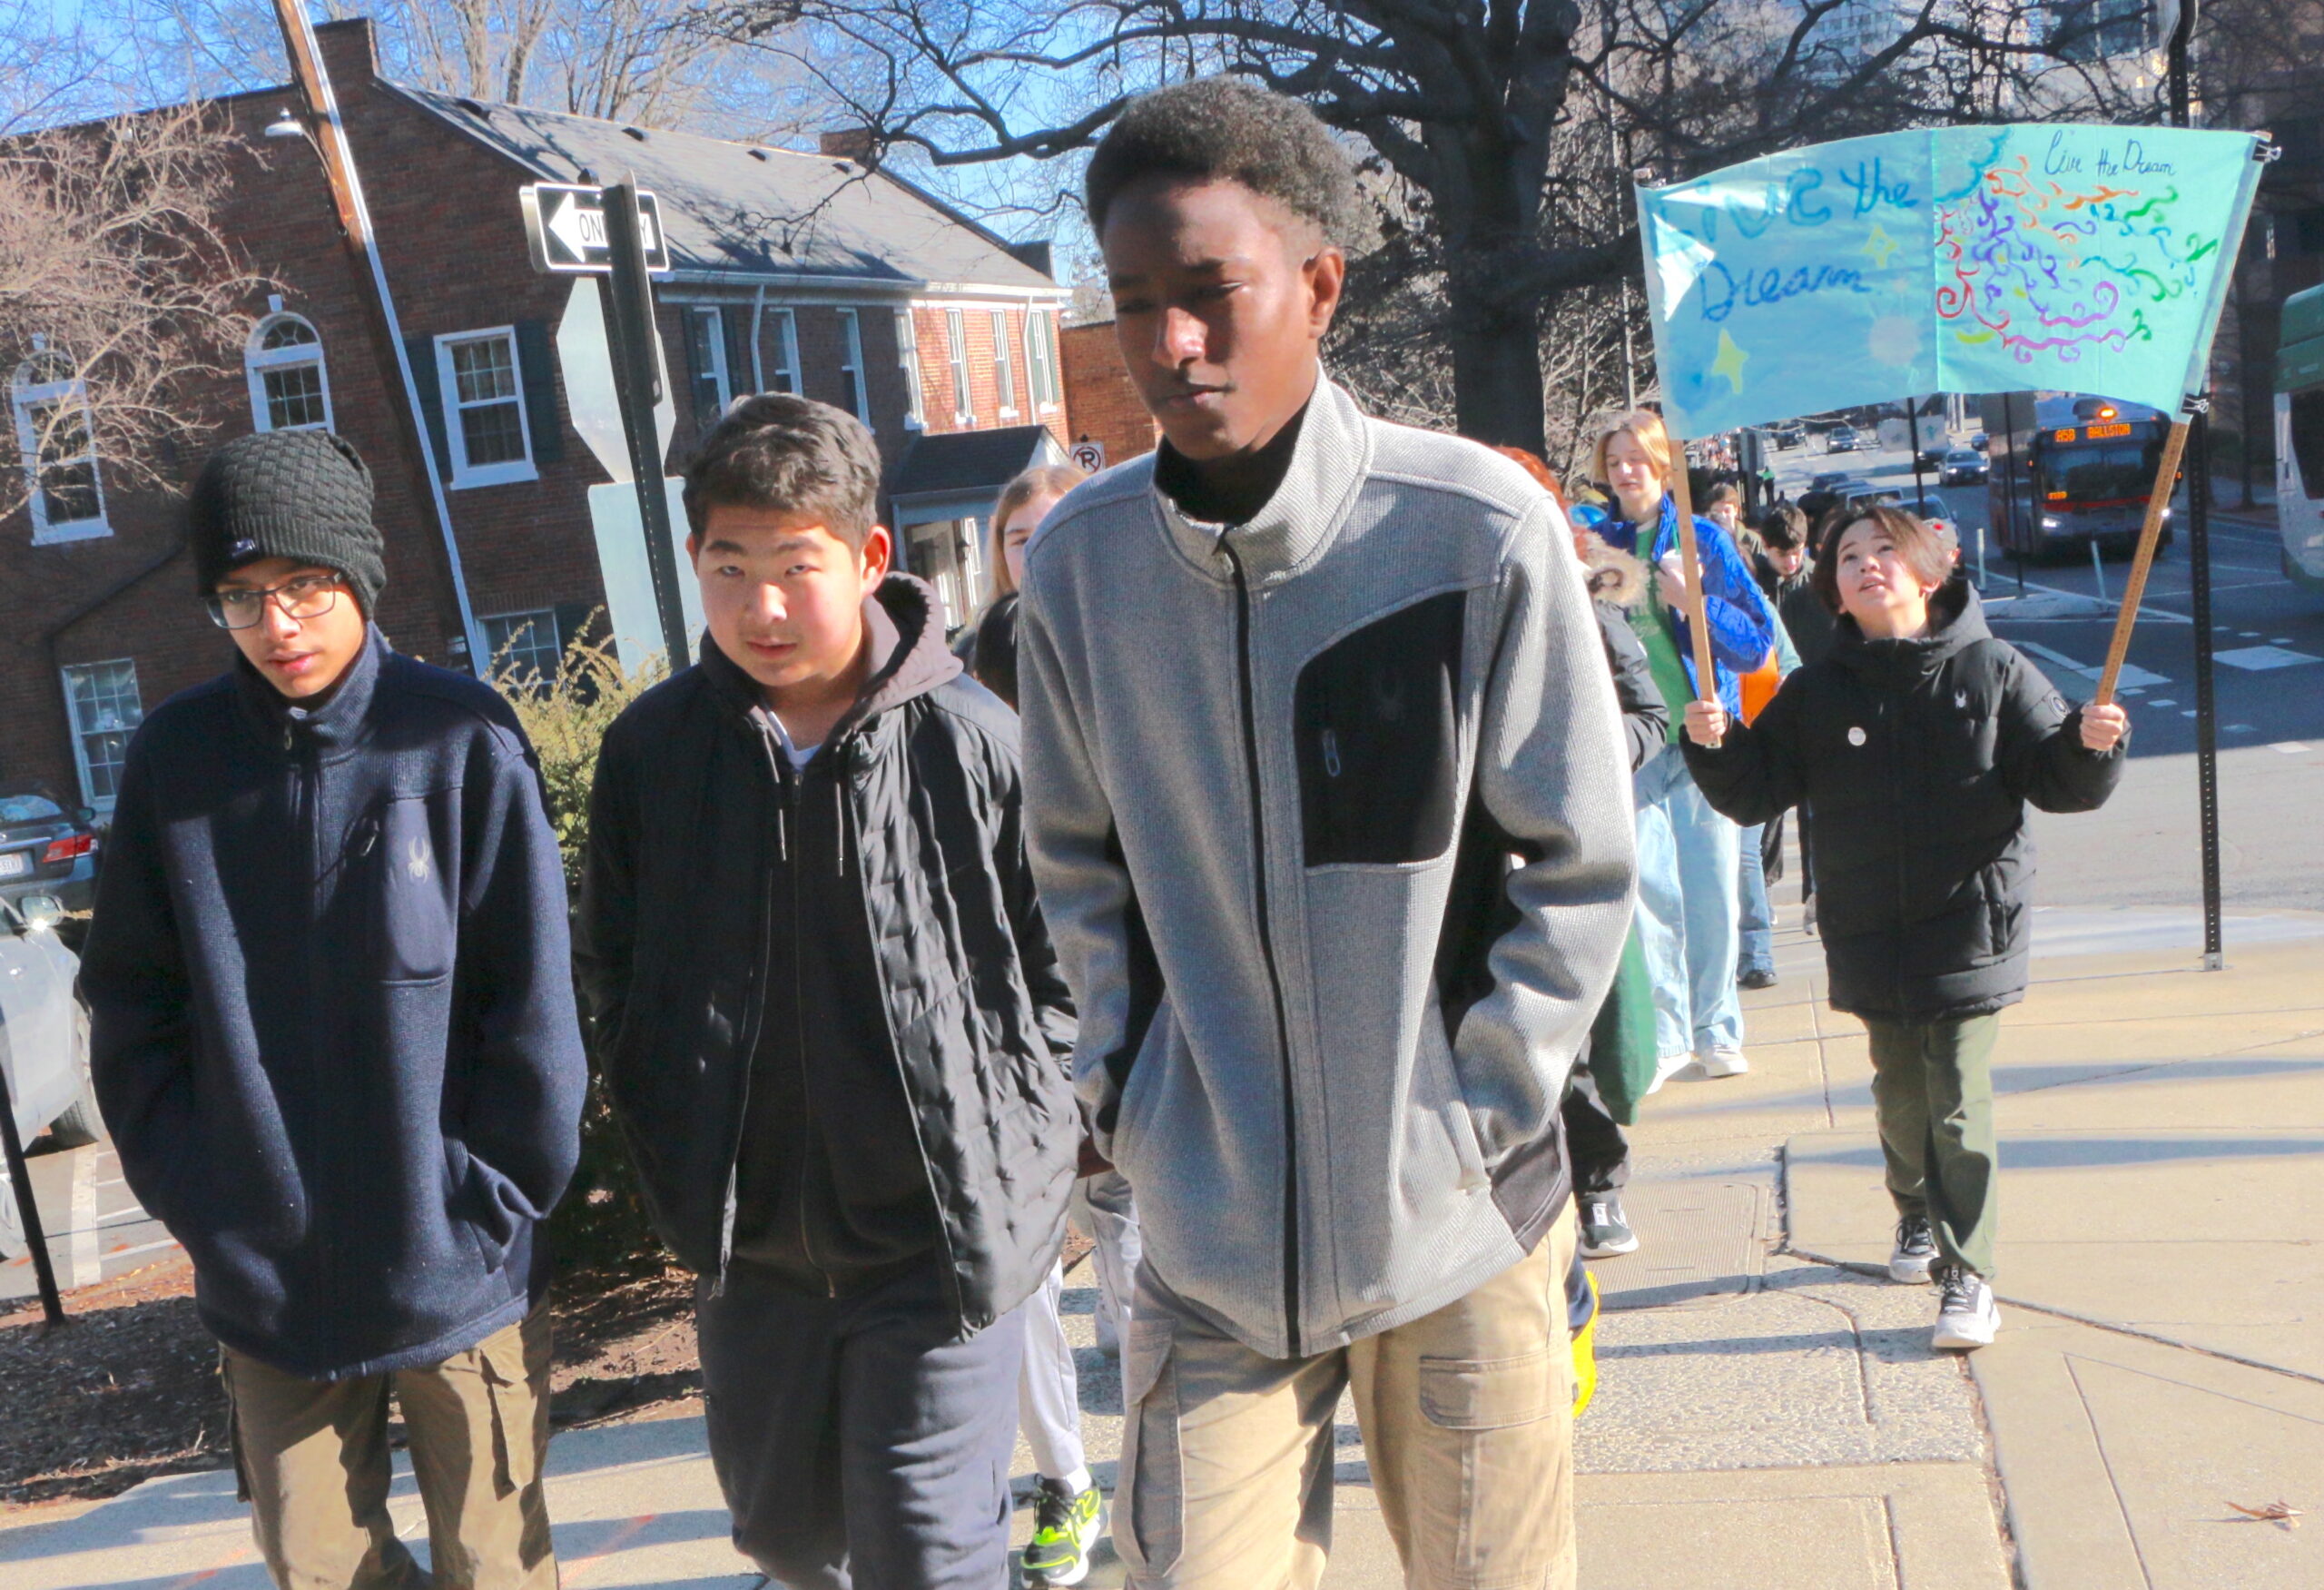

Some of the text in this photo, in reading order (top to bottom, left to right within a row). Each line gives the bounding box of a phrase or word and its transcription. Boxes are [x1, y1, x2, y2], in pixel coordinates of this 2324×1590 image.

[2044, 129, 2176, 177] Live the Dream
[1838, 157, 1920, 220] the
[579, 212, 606, 242] ON
[2086, 423, 2131, 439] BALLSTON
